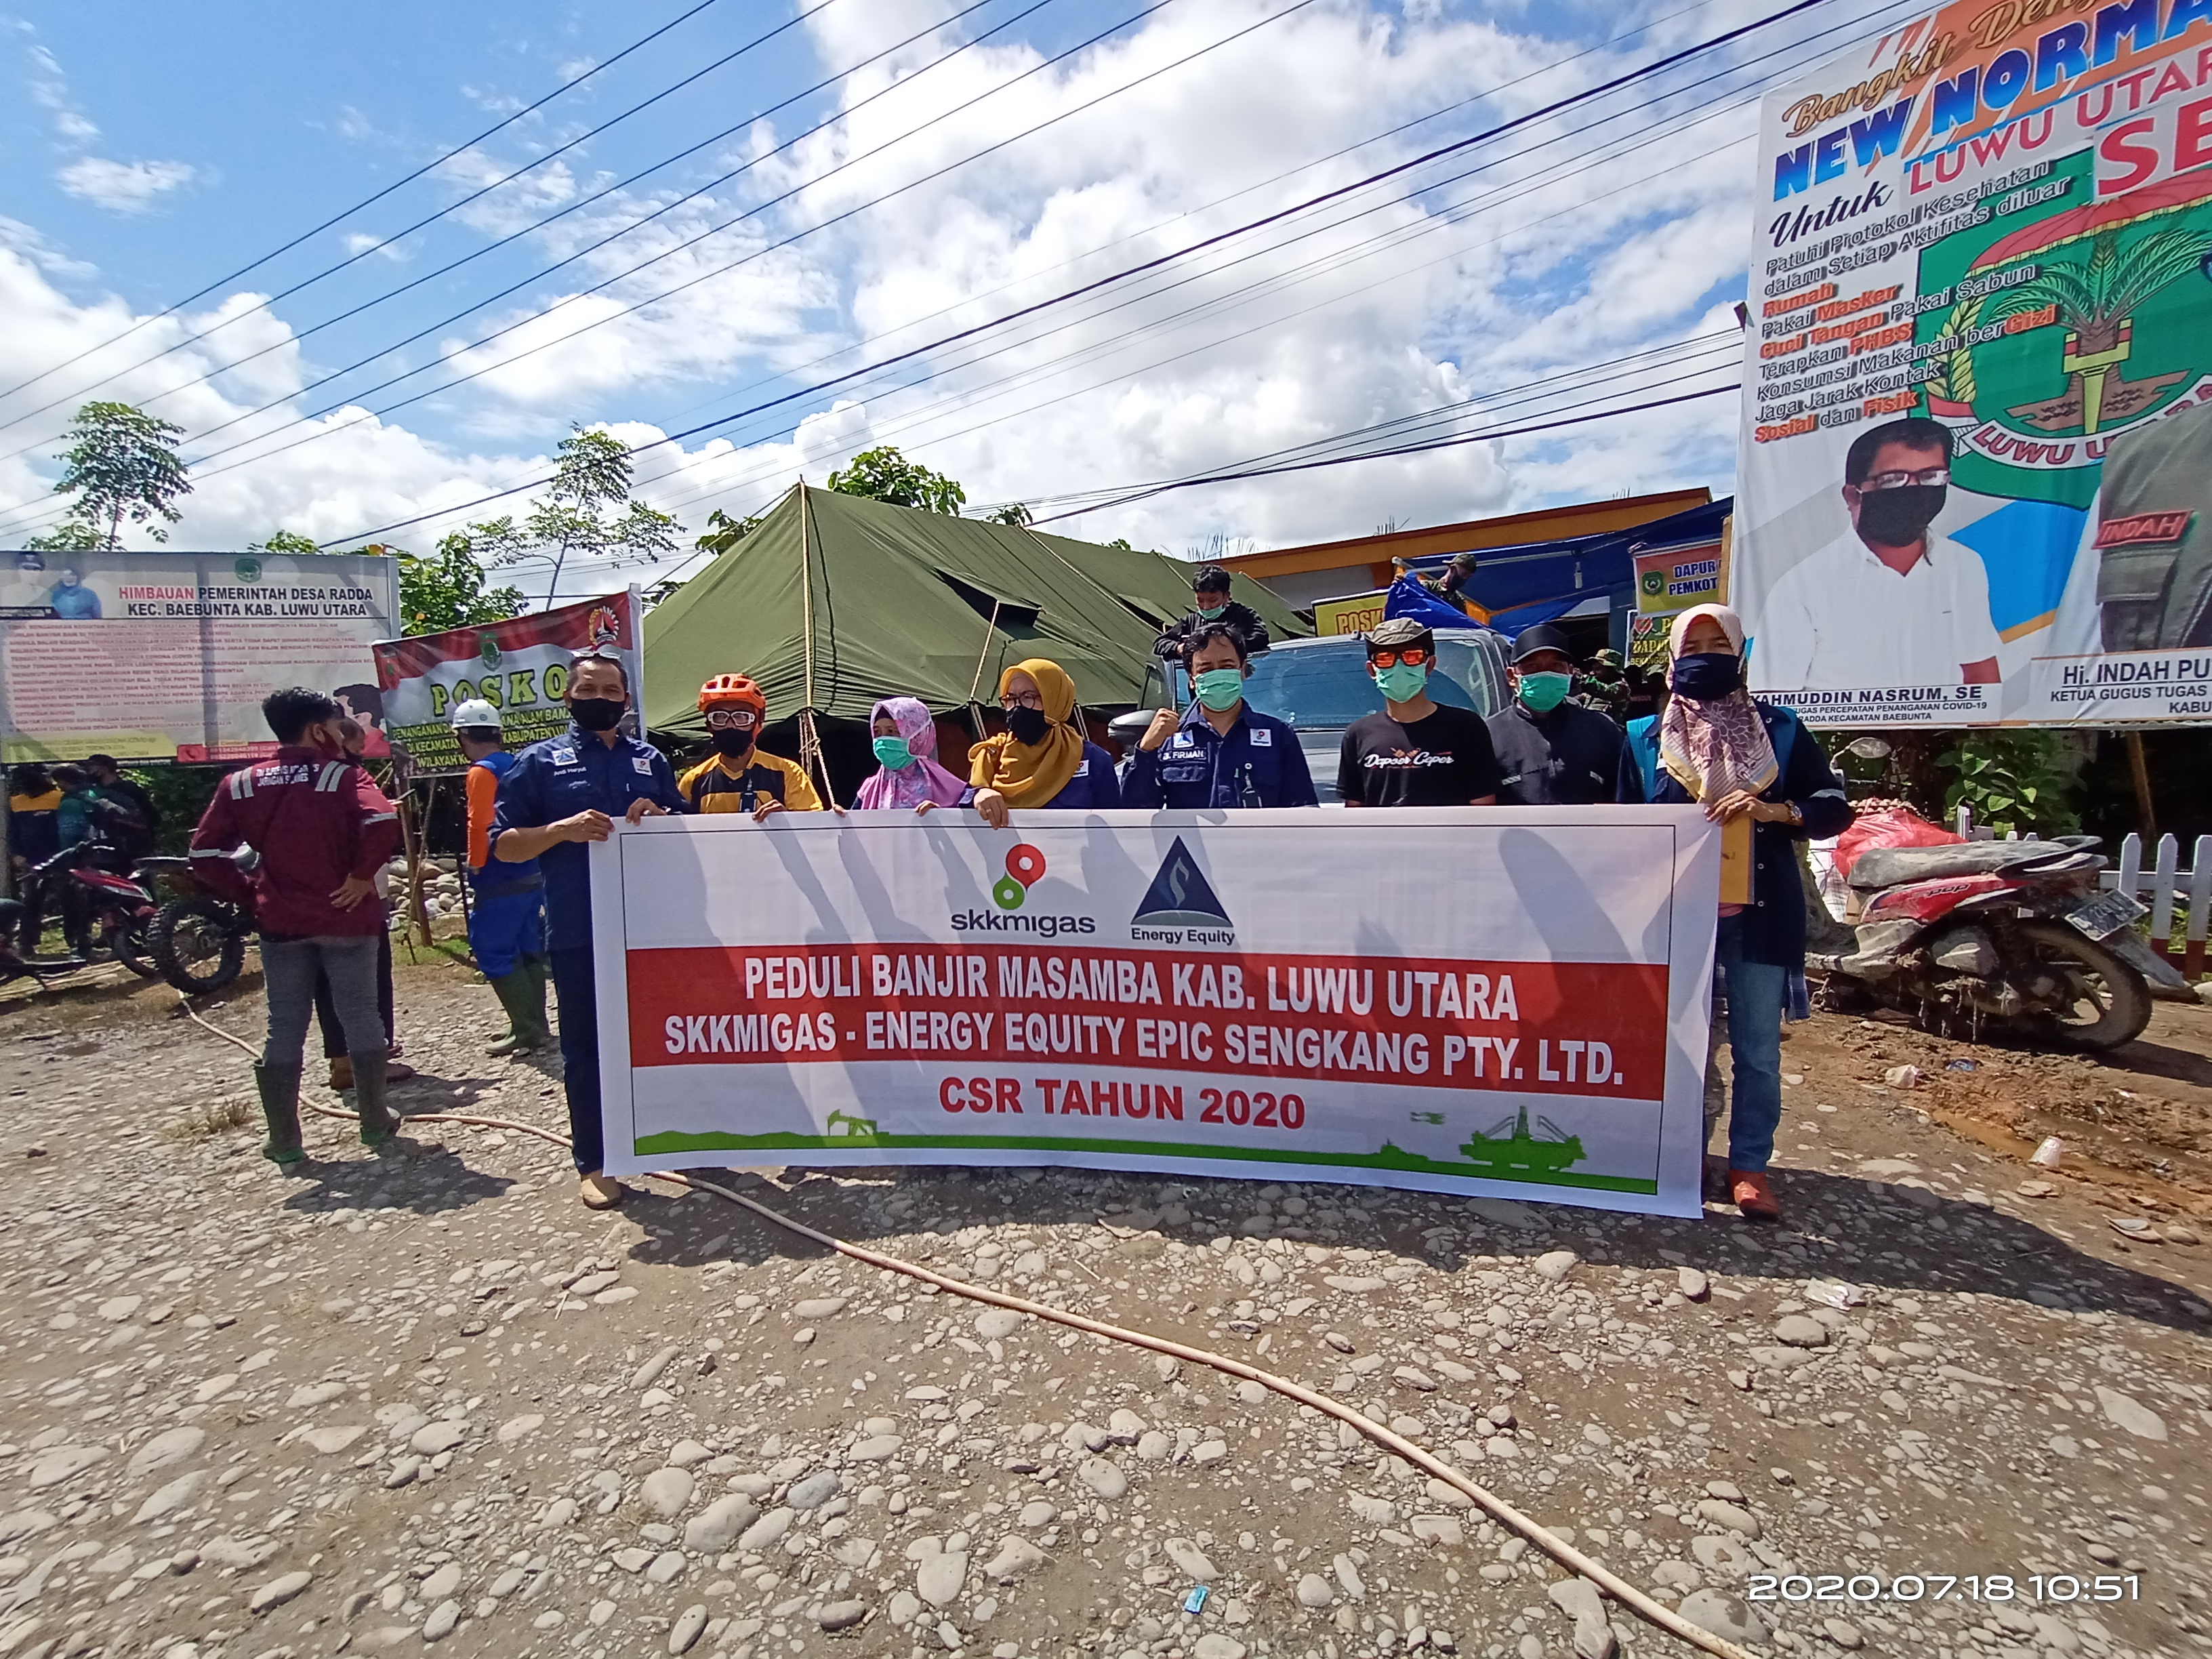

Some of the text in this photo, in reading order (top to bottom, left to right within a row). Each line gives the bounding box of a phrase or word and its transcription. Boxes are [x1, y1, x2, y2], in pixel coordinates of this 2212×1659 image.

[1782, 31, 1956, 138] Bangkit
[1773, 94, 1917, 203] NEW
[1768, 180, 1895, 248] Untuk
[1910, 107, 2054, 195] LUWU
[1764, 177, 2070, 296] dalam Setiap Aktifitas diluar
[1766, 162, 2049, 275] Patuhi Protokol Kesehatan
[1760, 265, 2036, 359] Cuci Tangan Pakai Sabun
[1761, 285, 1898, 337] Pakai Masker
[1762, 283, 1835, 318] Rumah
[1757, 304, 2057, 401] Konsumsi Makanan berGizi
[1759, 322, 1914, 380] Terapkan PHBS
[1755, 361, 1941, 422] Jaga Jarak Kontak
[1754, 390, 1918, 443] Sosial dan Fisik
[1973, 425, 2075, 465] LUWU
[2102, 515, 2182, 539] INDAH
[1668, 577, 1719, 596] PEMKOT
[1674, 560, 1717, 578] DAPUR
[119, 586, 373, 600] HIMBAUAN PEMERINTAH DESA RADDA
[127, 603, 367, 617] KEC. BAEBUNTA KAB. LUWU UTARA
[2097, 661, 2170, 683] INDAH
[2177, 658, 2212, 680] PU
[430, 663, 568, 717] POSKO
[1820, 705, 1875, 714] PERCEPATAN
[1877, 703, 1940, 712] PENANGANAN
[1942, 701, 1987, 710] COVID-19
[1859, 687, 1948, 703] NASRUM,
[1955, 686, 1982, 699] SE
[2051, 685, 2207, 702] KETUA GUGUS TUGAS
[503, 727, 552, 743] KABUPATEN
[1828, 714, 1881, 722] KECAMATAN
[416, 754, 458, 767] WILAYAH
[1172, 750, 1204, 760] FIRMAN
[950, 908, 1097, 939] skkmigas
[1131, 927, 1235, 947] Energy Equity
[745, 955, 1519, 1021] PEDULI BANJIR MASAMBA KAB. LUWU UTARA
[665, 1011, 1624, 1086] SKKMIGAS - ENERGY EQUITY EPIC SENGKANG PTY. LTD.
[939, 1076, 1306, 1130] CSR TAHUN 2020
